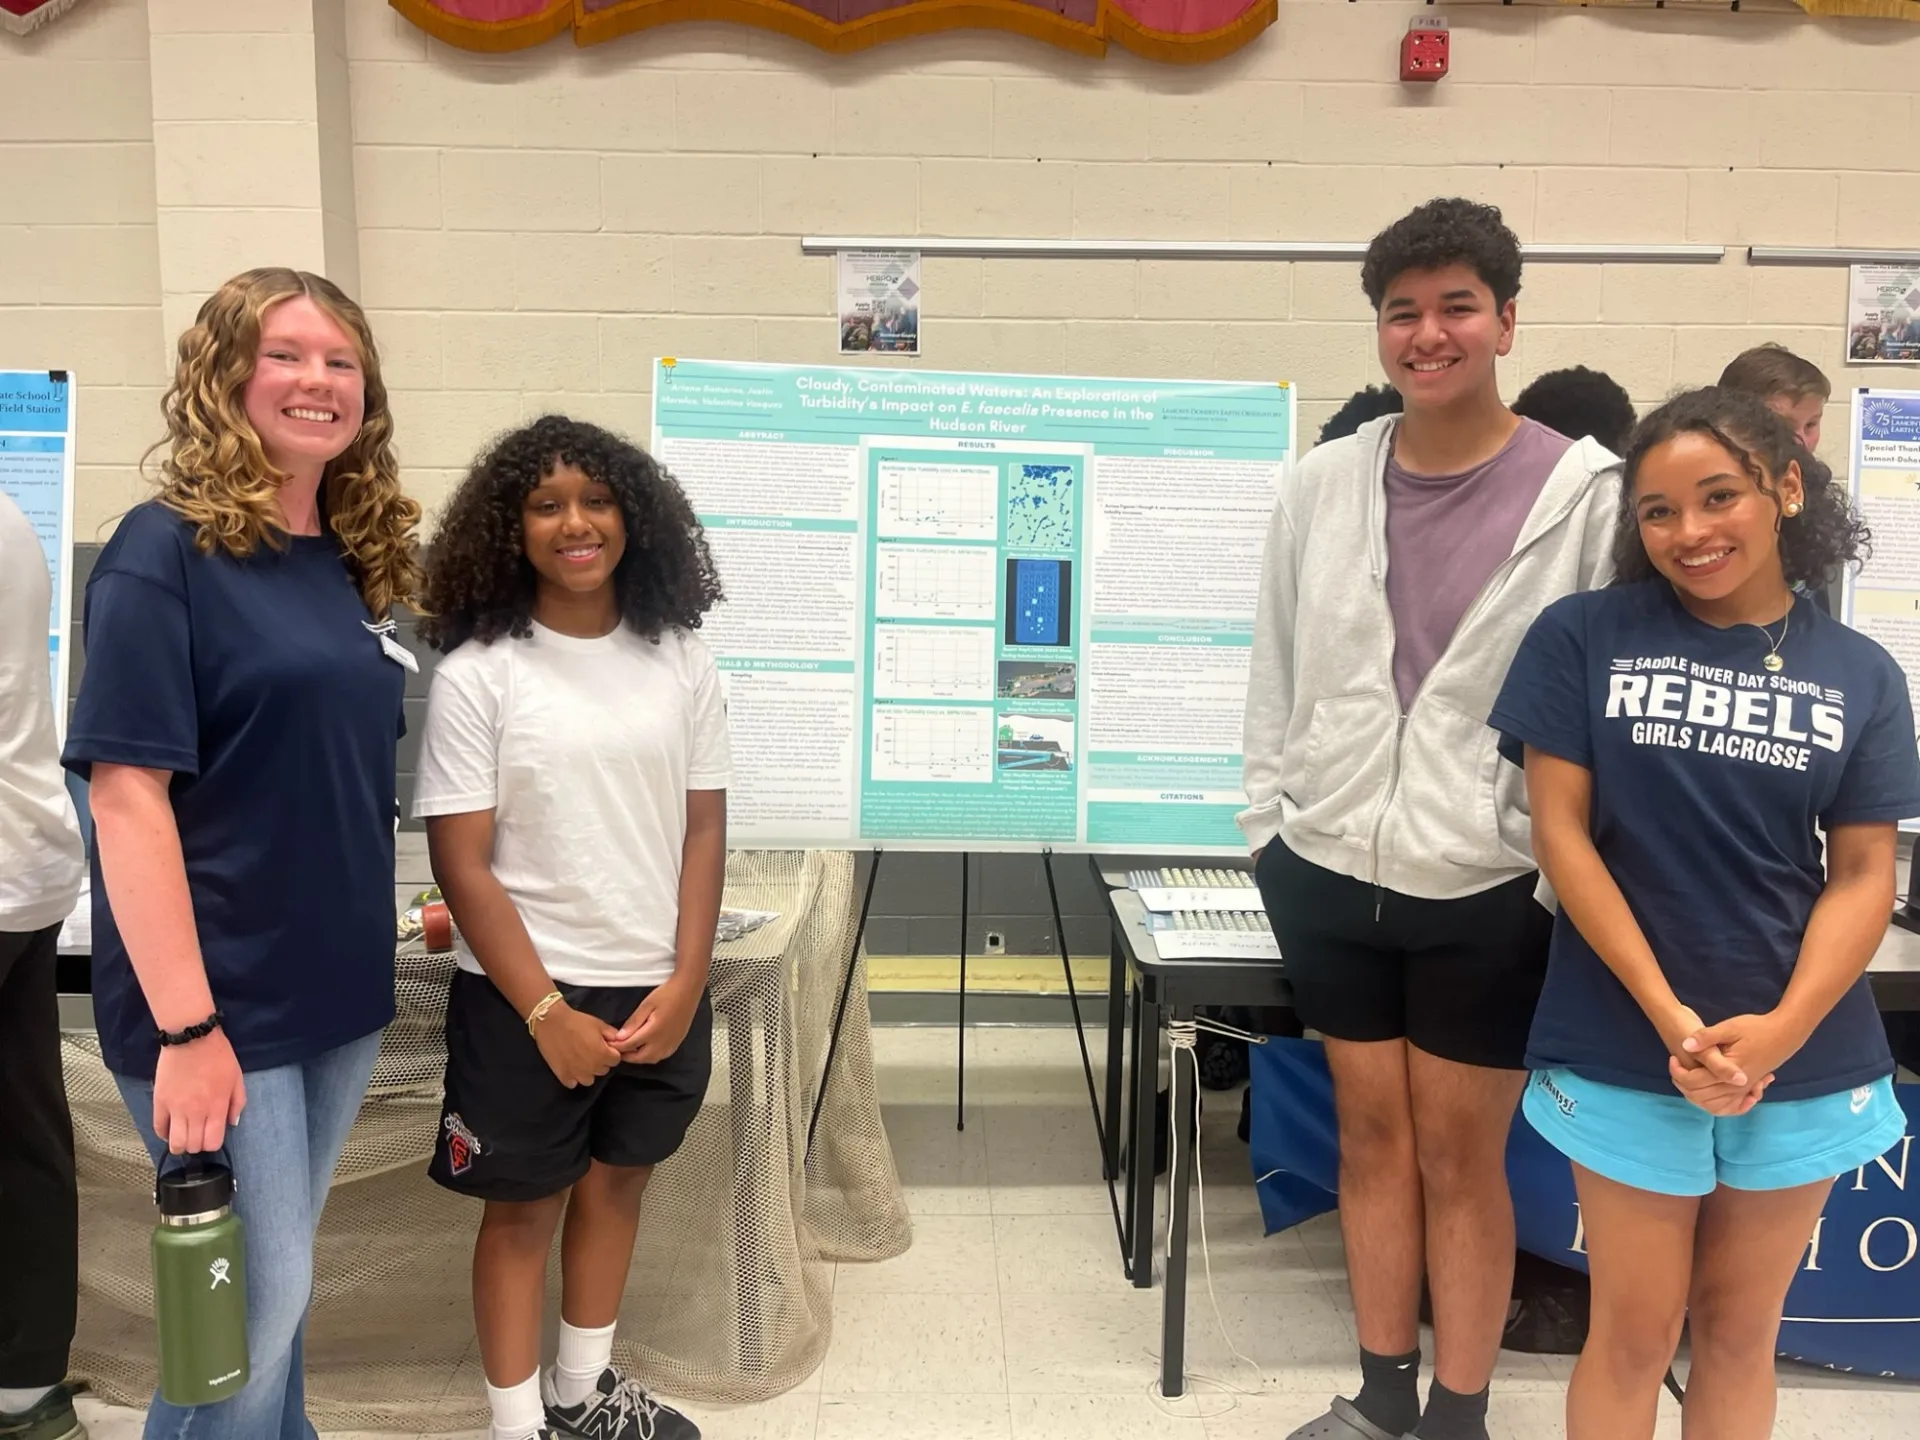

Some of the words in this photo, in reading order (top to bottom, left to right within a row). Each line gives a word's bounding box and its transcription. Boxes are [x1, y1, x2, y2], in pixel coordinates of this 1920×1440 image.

[796, 377, 853, 394] Cloudy,
[858, 380, 965, 395] Contaminated
[969, 383, 1028, 398] Waters:
[1031, 387, 1051, 399] An
[1056, 388, 1138, 402] Exploration
[1143, 390, 1158, 403] of
[16, 391, 50, 400] School
[0, 403, 23, 412] Field
[26, 404, 61, 413] Station
[882, 398, 934, 414] Impact
[938, 403, 956, 412] on
[961, 401, 973, 413] E.
[978, 401, 1038, 416] faecalis
[1042, 406, 1109, 419] Presence
[1113, 407, 1126, 419] in
[1131, 408, 1154, 420] the
[1876, 412, 1890, 426] 75
[929, 418, 985, 432] Hudson
[990, 420, 1026, 433] River
[739, 431, 784, 440] ABSTRACT
[958, 441, 996, 449] RESULTS
[1865, 444, 1896, 452] Special
[1163, 448, 1215, 456] DISCUSSION
[1864, 455, 1920, 463] Lamont-Dohe
[726, 518, 793, 528] INTRODUCTION
[753, 662, 820, 670] METHODOLOGY
[1634, 656, 1687, 672] SADDLE
[1690, 662, 1732, 685] RIVER
[1738, 672, 1766, 688] DAY
[1770, 675, 1823, 700] SCHOOL
[1605, 674, 1844, 753] REBELS
[1632, 722, 1693, 749] GIRLS
[1698, 730, 1811, 772] LACROSSE
[1137, 755, 1228, 764] ACKNOWLEDGEMENTS
